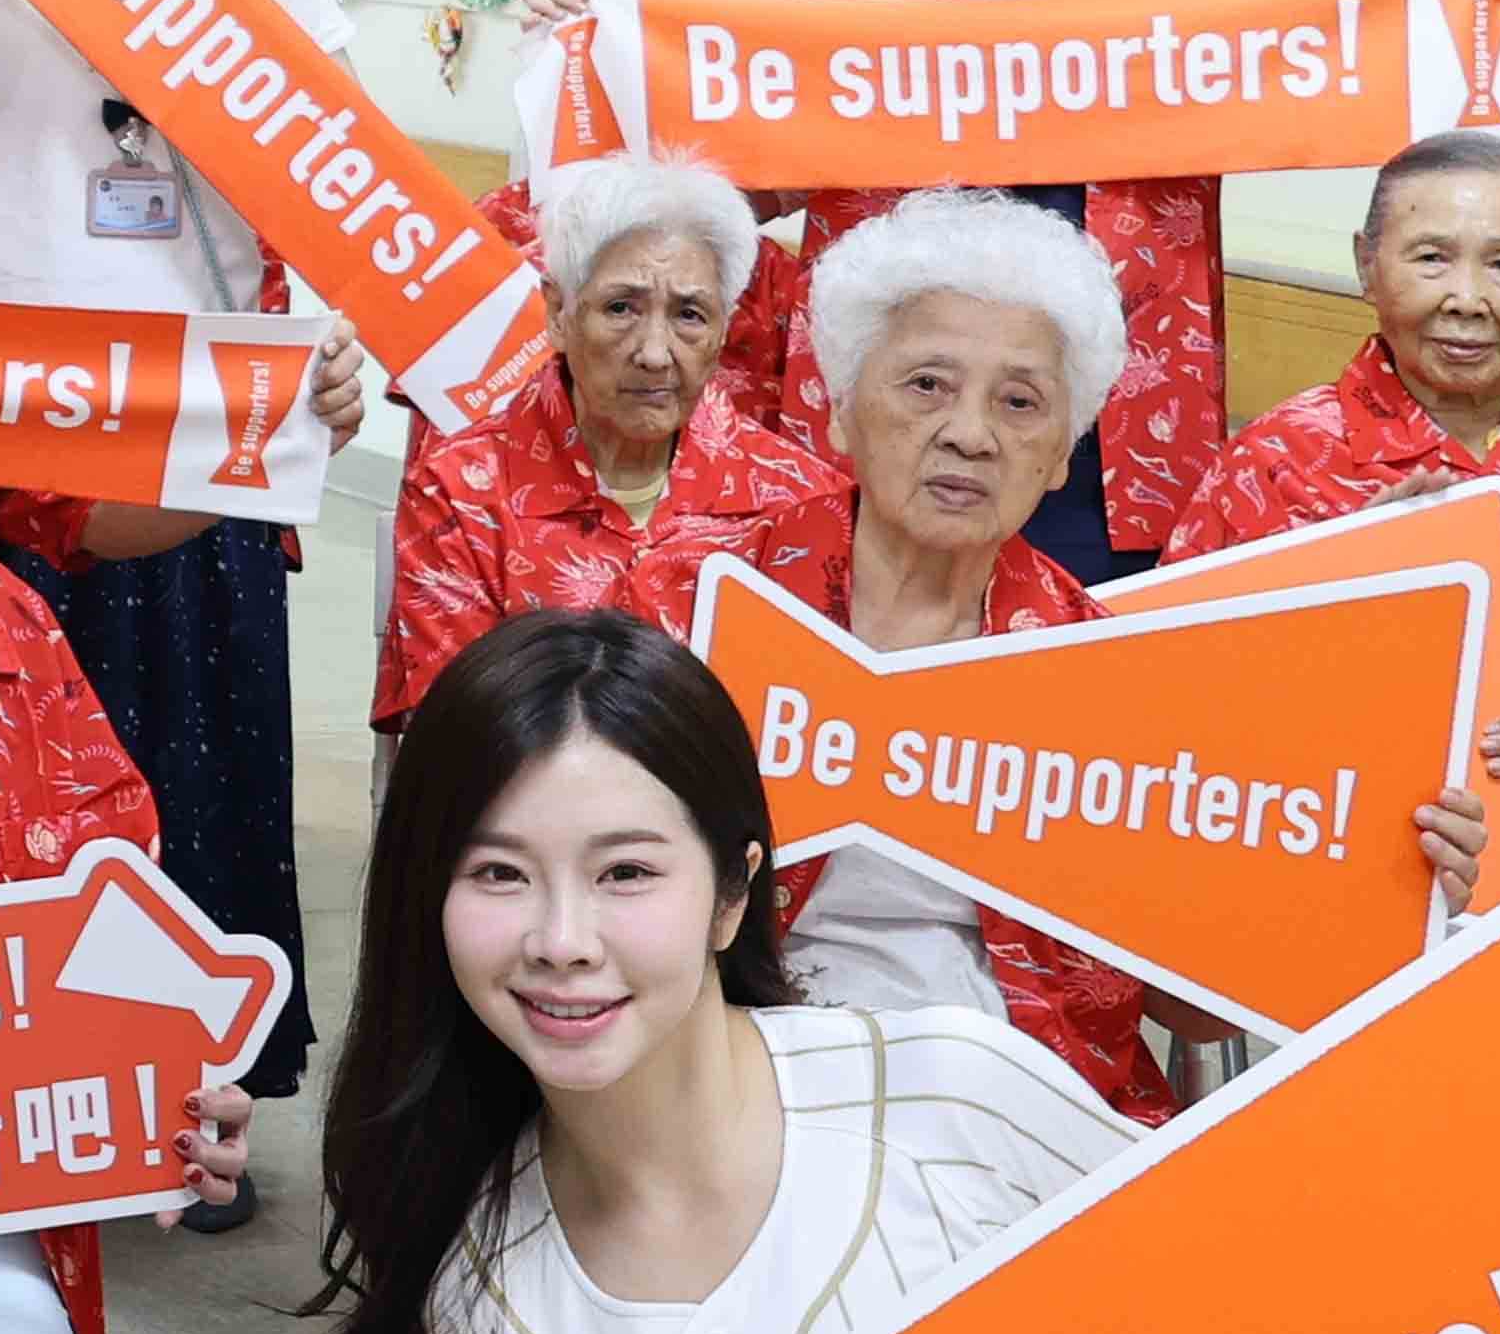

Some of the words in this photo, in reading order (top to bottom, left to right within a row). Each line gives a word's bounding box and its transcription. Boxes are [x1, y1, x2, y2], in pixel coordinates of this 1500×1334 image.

[688, 24, 797, 122] Be
[759, 685, 858, 788] Be
[884, 728, 1358, 862] supporters!
